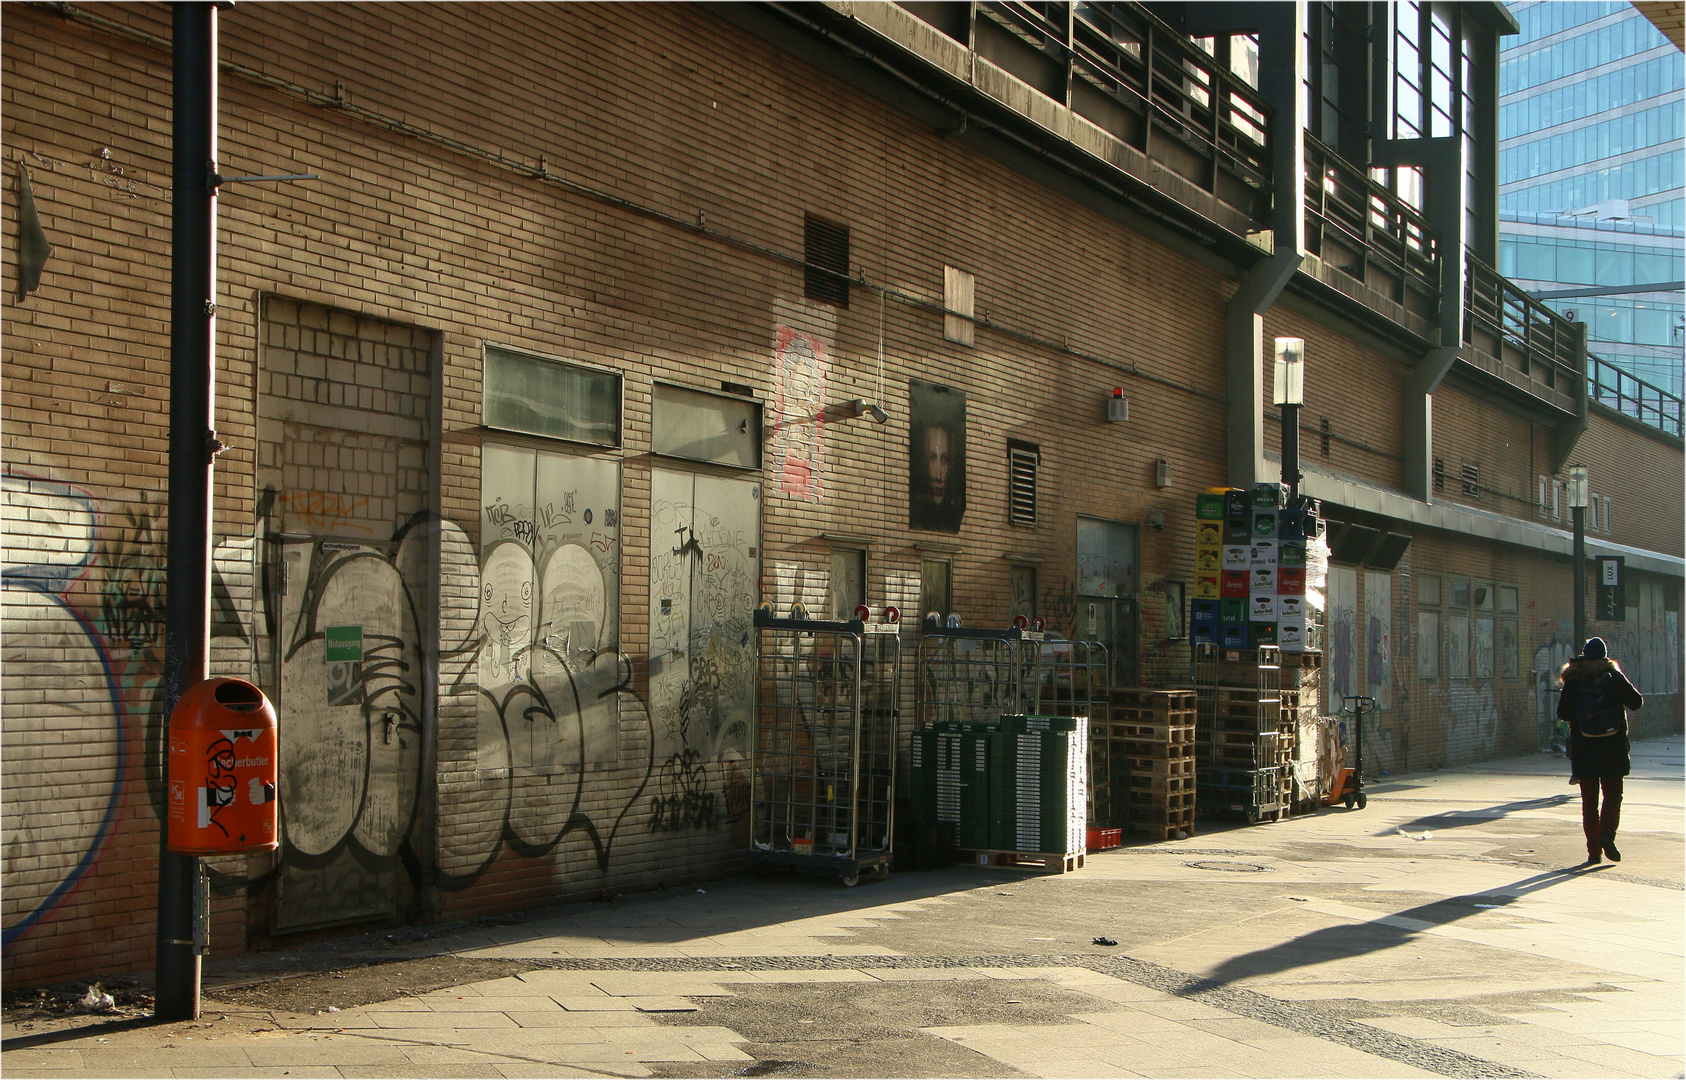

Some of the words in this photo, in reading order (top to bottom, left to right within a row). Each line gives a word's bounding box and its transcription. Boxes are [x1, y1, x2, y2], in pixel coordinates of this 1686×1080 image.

[1566, 311, 1574, 322] 9
[323, 543, 361, 551] schnellejugend
[1606, 565, 1614, 580] LUX
[328, 639, 361, 650] Notausgang
